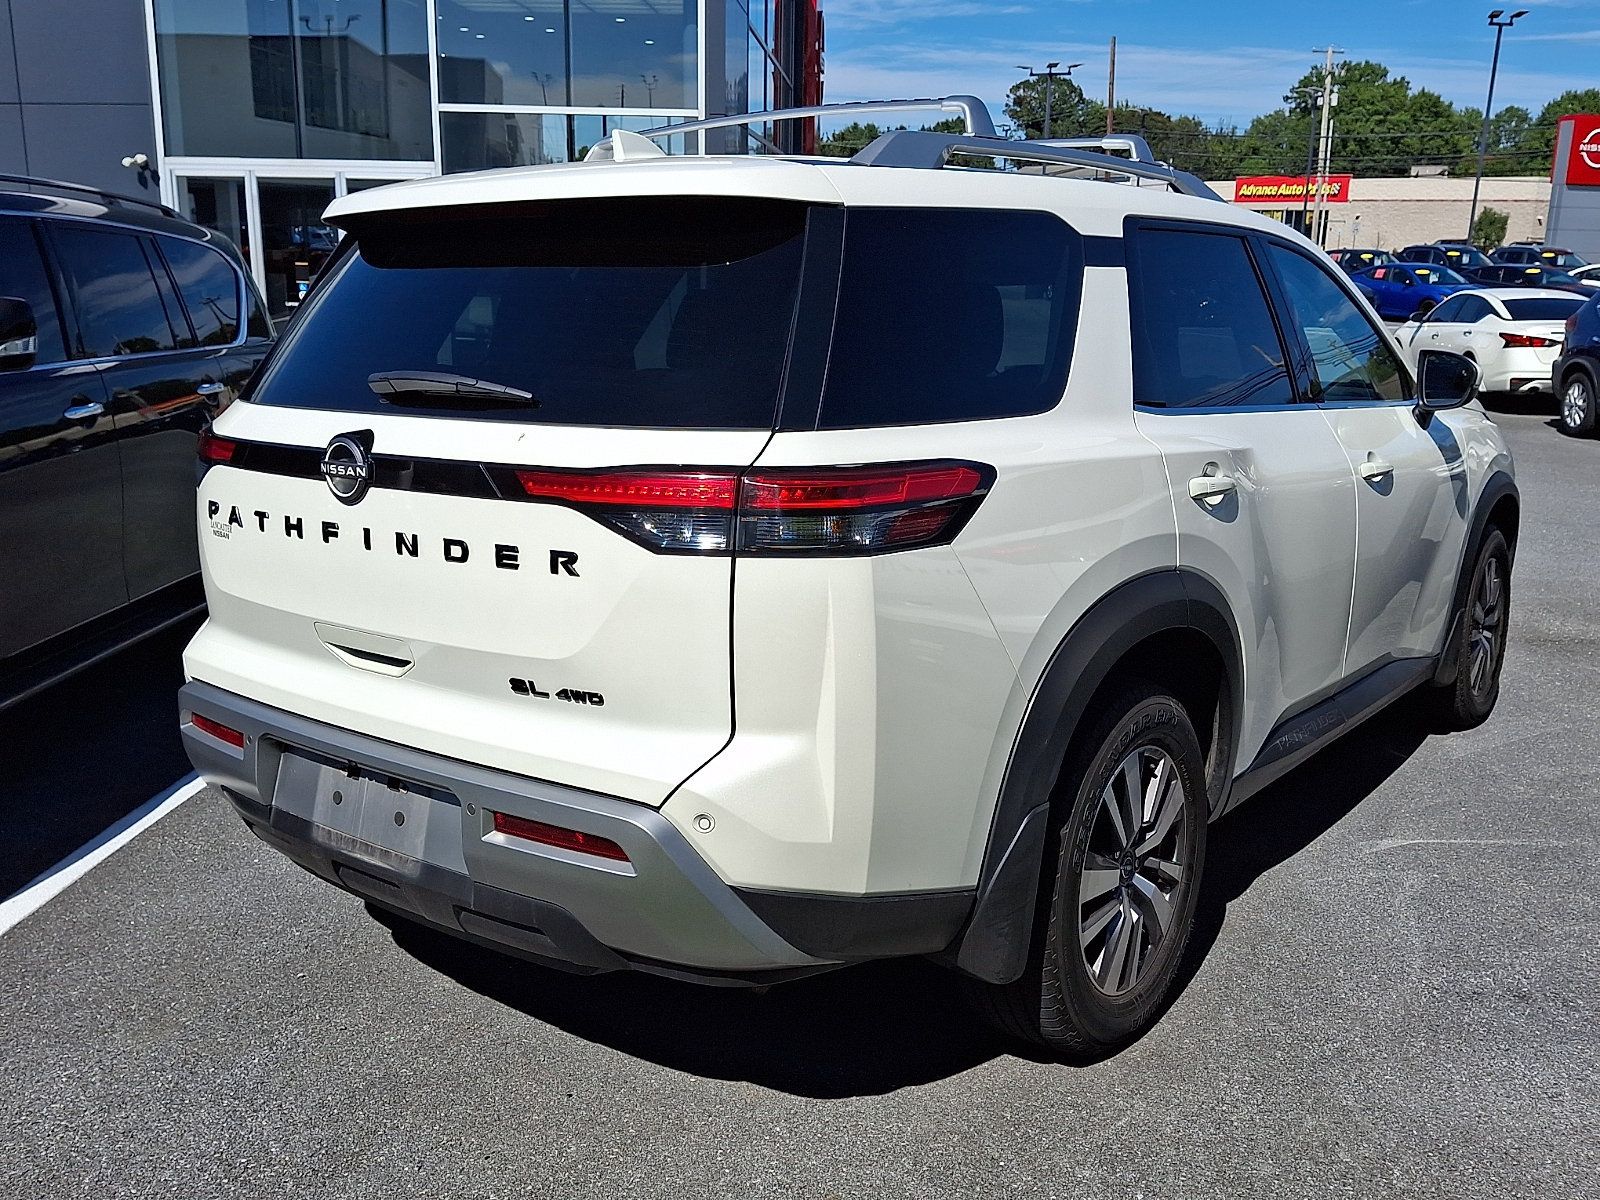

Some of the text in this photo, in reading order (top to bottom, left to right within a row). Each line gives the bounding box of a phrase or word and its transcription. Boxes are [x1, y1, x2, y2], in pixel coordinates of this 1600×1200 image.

[1239, 183, 1278, 196] Advance
[1277, 183, 1302, 195] Auto
[320, 462, 366, 477] NISSAN
[208, 499, 580, 578] PATHFINDER
[212, 529, 230, 540] NISSAN
[508, 677, 605, 707] SL 4WD
